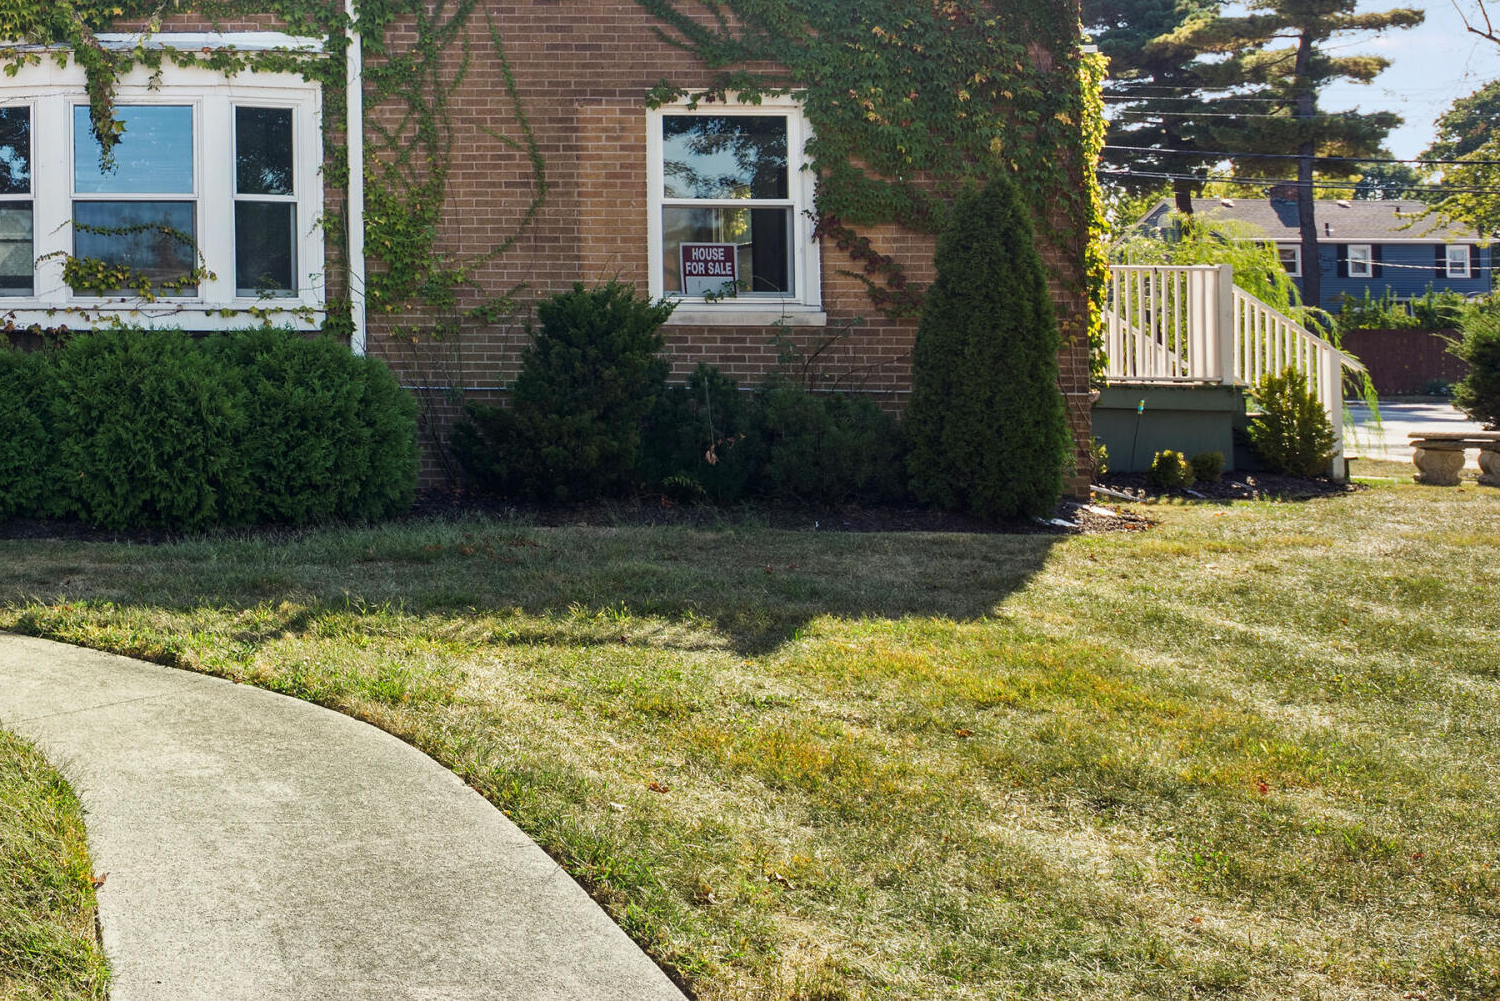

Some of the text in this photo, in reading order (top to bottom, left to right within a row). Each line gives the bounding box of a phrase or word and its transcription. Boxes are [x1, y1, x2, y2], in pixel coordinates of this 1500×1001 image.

[691, 247, 725, 261] HOUSE
[685, 261, 733, 275] FOR SALE
